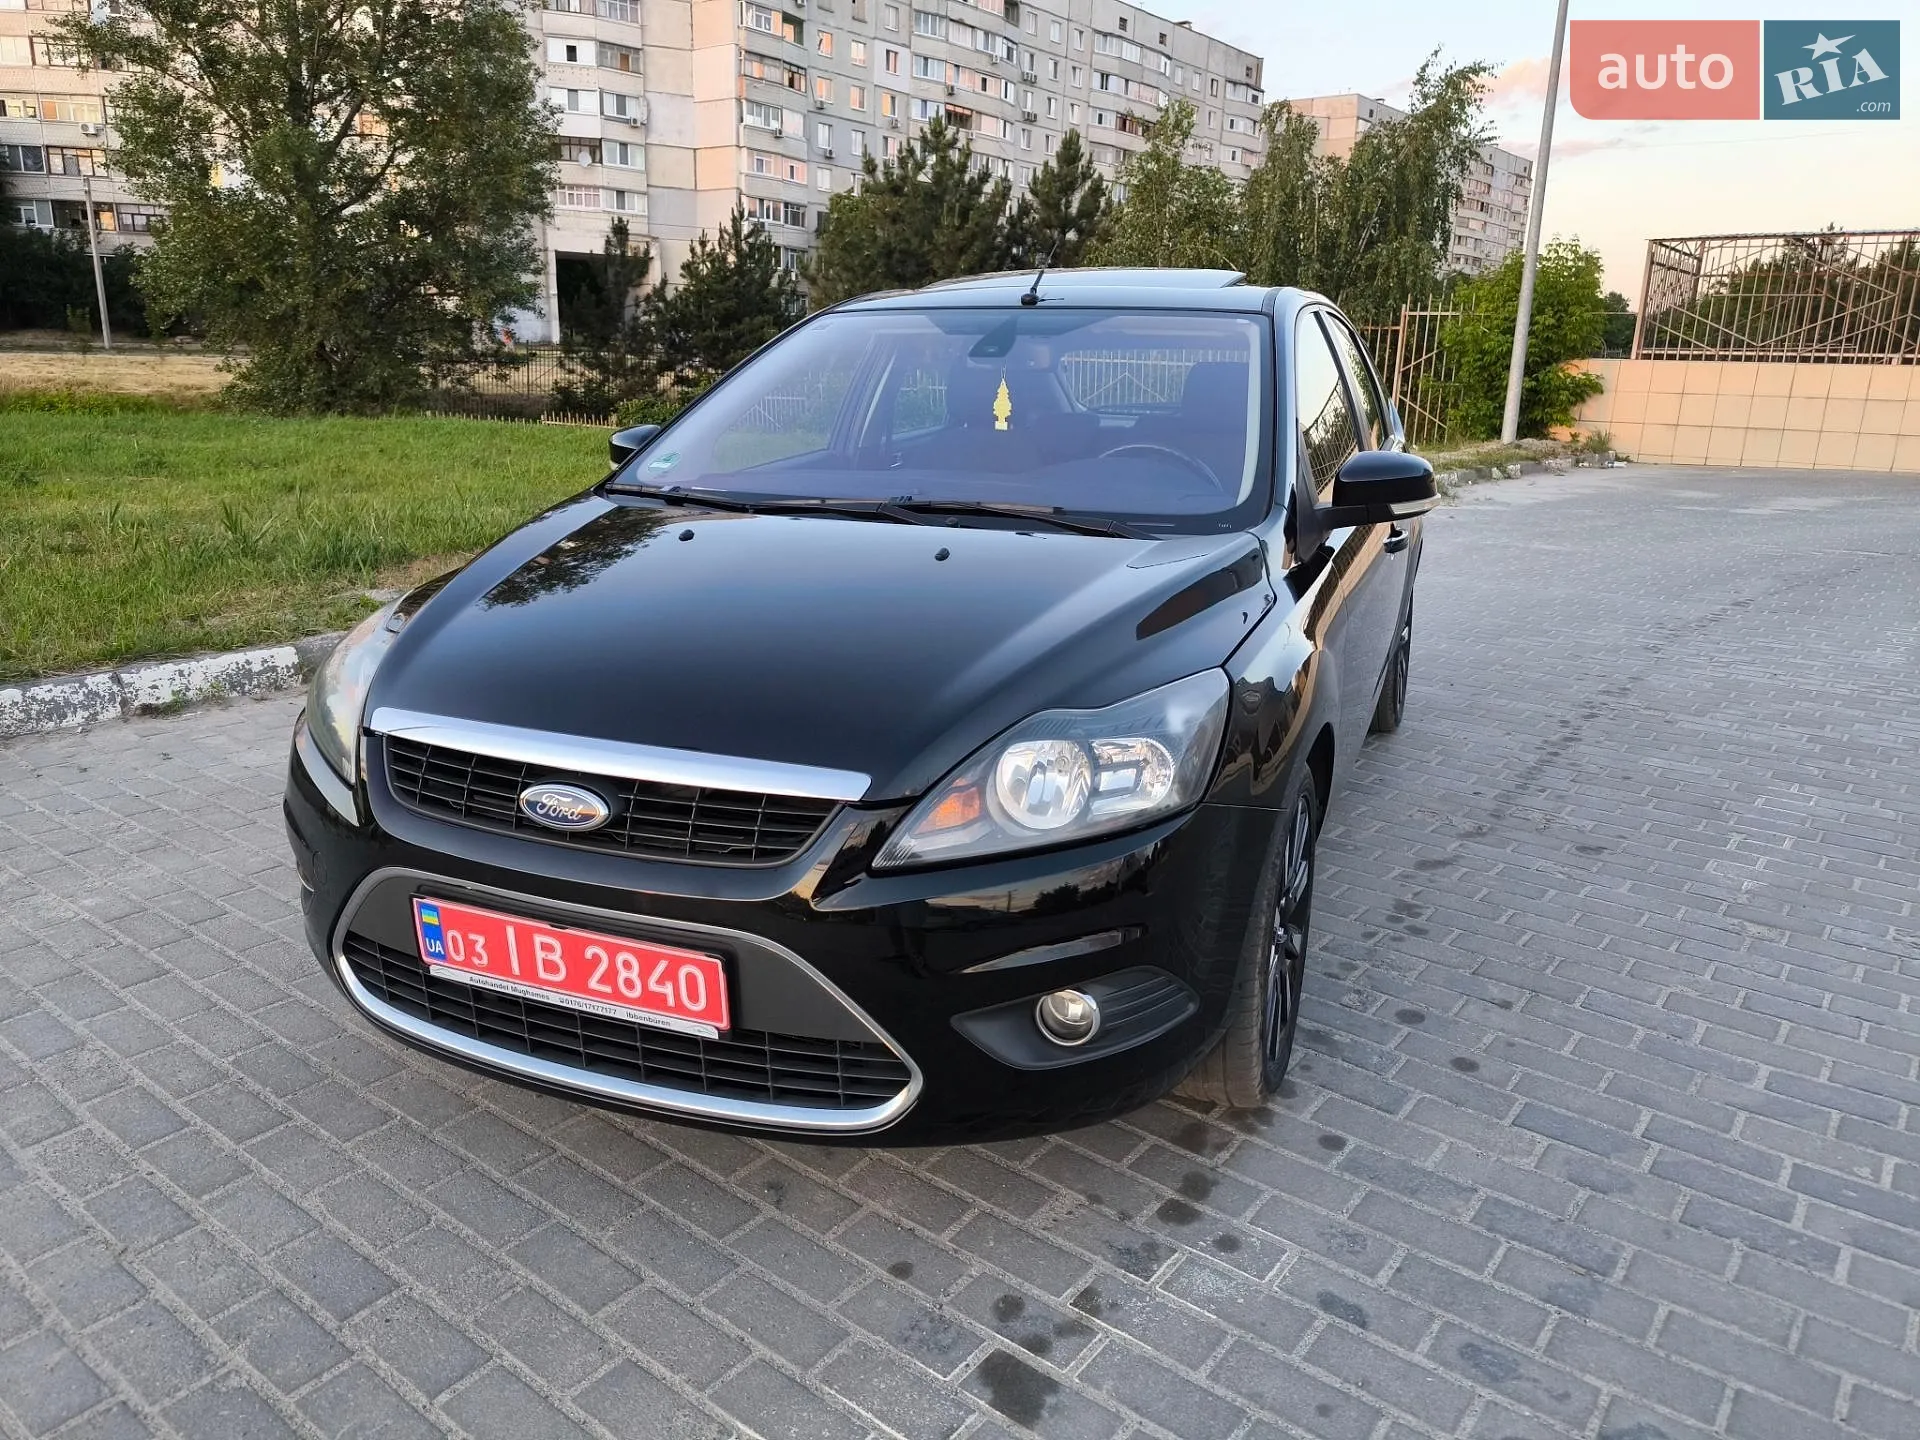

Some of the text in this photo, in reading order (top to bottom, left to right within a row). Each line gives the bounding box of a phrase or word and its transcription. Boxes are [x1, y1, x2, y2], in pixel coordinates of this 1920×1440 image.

[536, 793, 582, 820] Ford
[425, 937, 445, 955] UA
[446, 925, 707, 1012] 03 IB 2840
